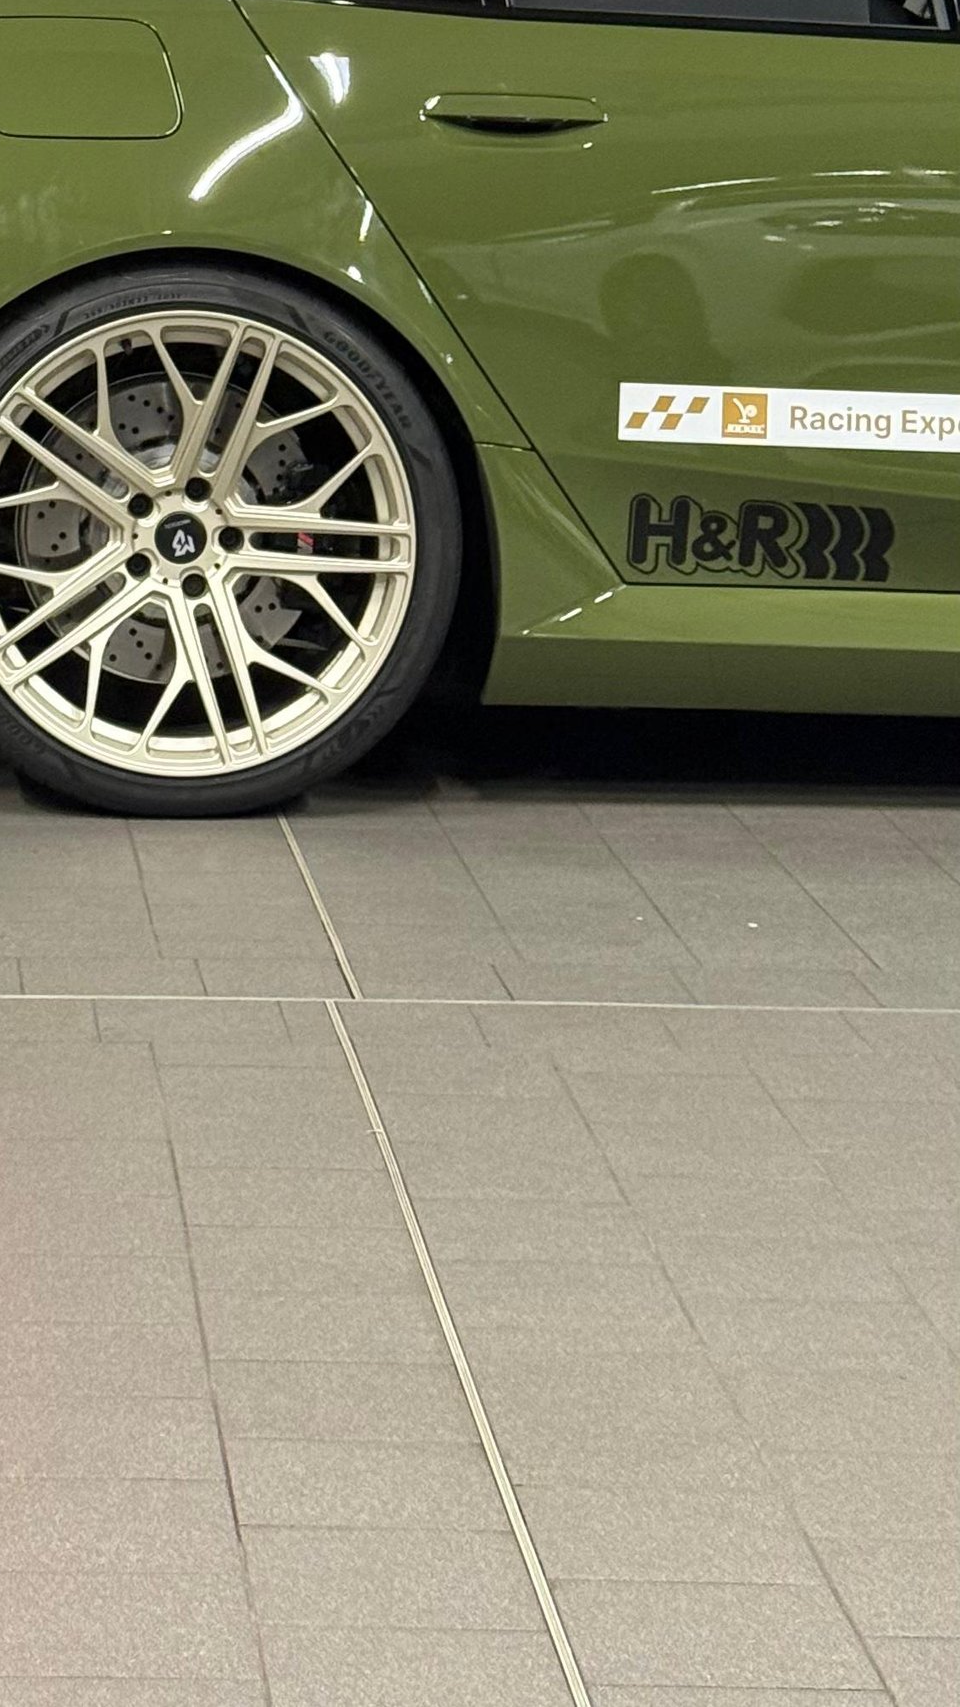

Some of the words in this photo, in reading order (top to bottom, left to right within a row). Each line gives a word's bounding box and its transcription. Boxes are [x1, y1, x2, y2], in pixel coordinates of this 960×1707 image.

[789, 405, 891, 439] Racing
[900, 409, 960, 441] Exp
[626, 492, 803, 580] H&R
